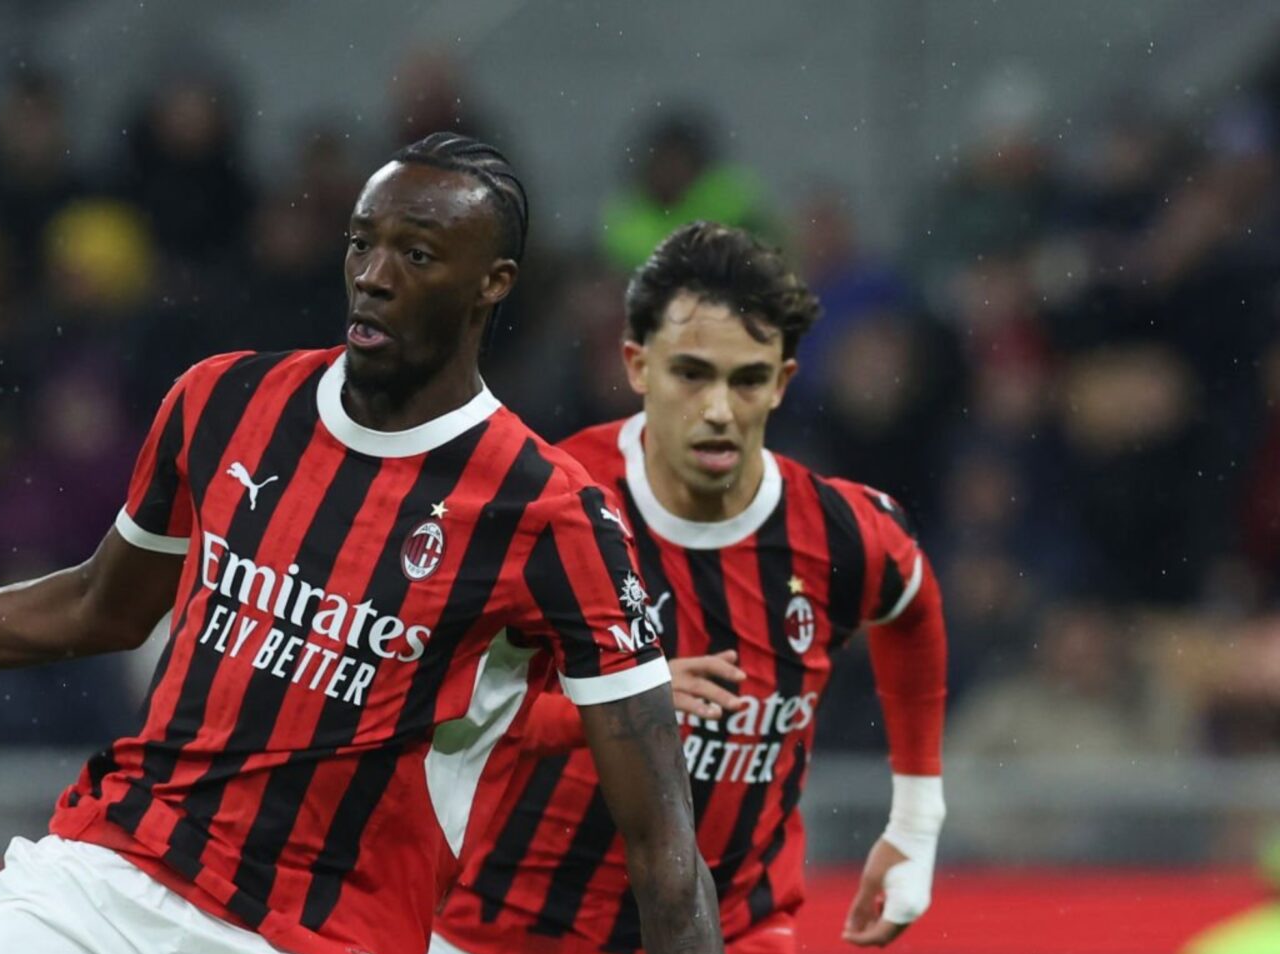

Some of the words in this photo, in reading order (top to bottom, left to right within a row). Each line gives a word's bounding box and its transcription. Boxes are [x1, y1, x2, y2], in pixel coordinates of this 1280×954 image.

[201, 530, 432, 662] Emirates
[200, 604, 258, 658] FLY
[252, 627, 376, 706] BETTER
